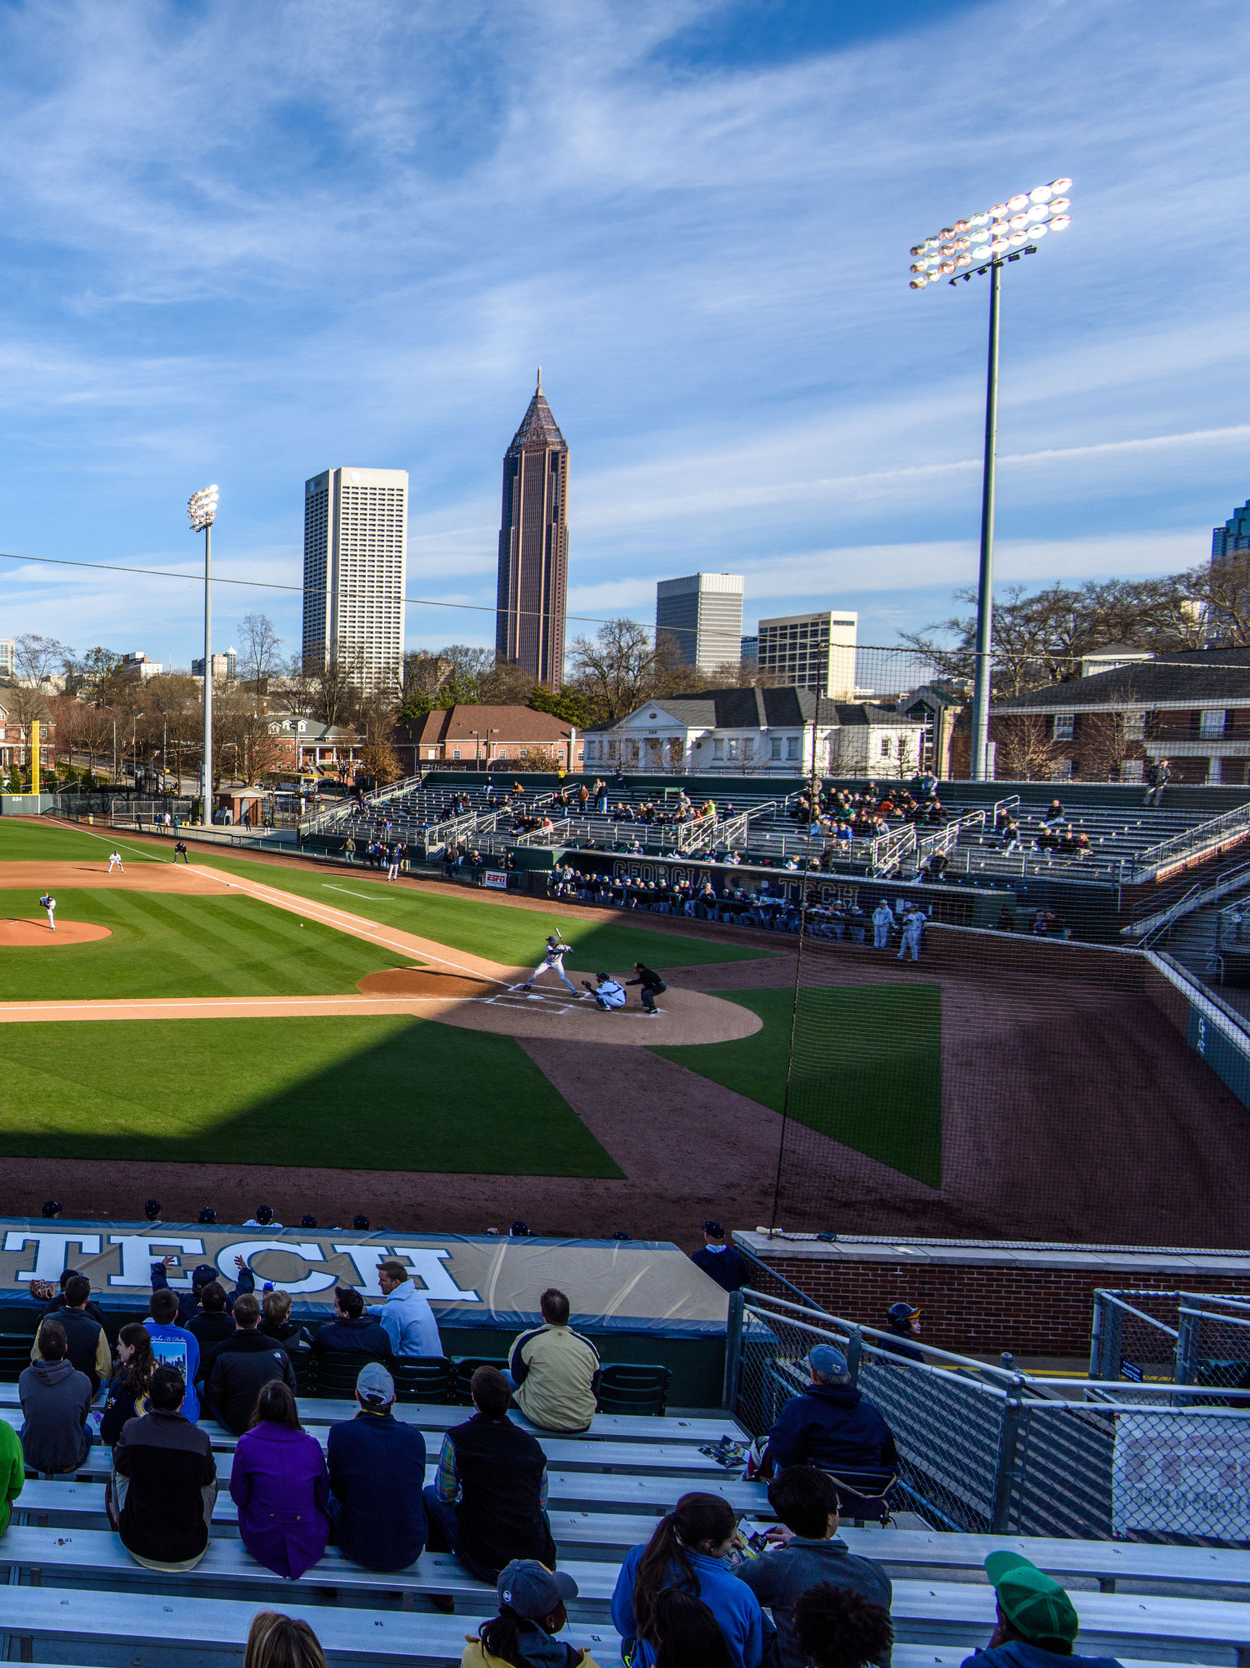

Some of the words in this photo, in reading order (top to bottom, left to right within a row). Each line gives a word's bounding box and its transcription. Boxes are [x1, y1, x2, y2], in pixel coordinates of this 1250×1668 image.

[487, 874, 505, 883] ESPN
[613, 859, 713, 890] GEORGIA
[2, 1230, 483, 1303] TECH
